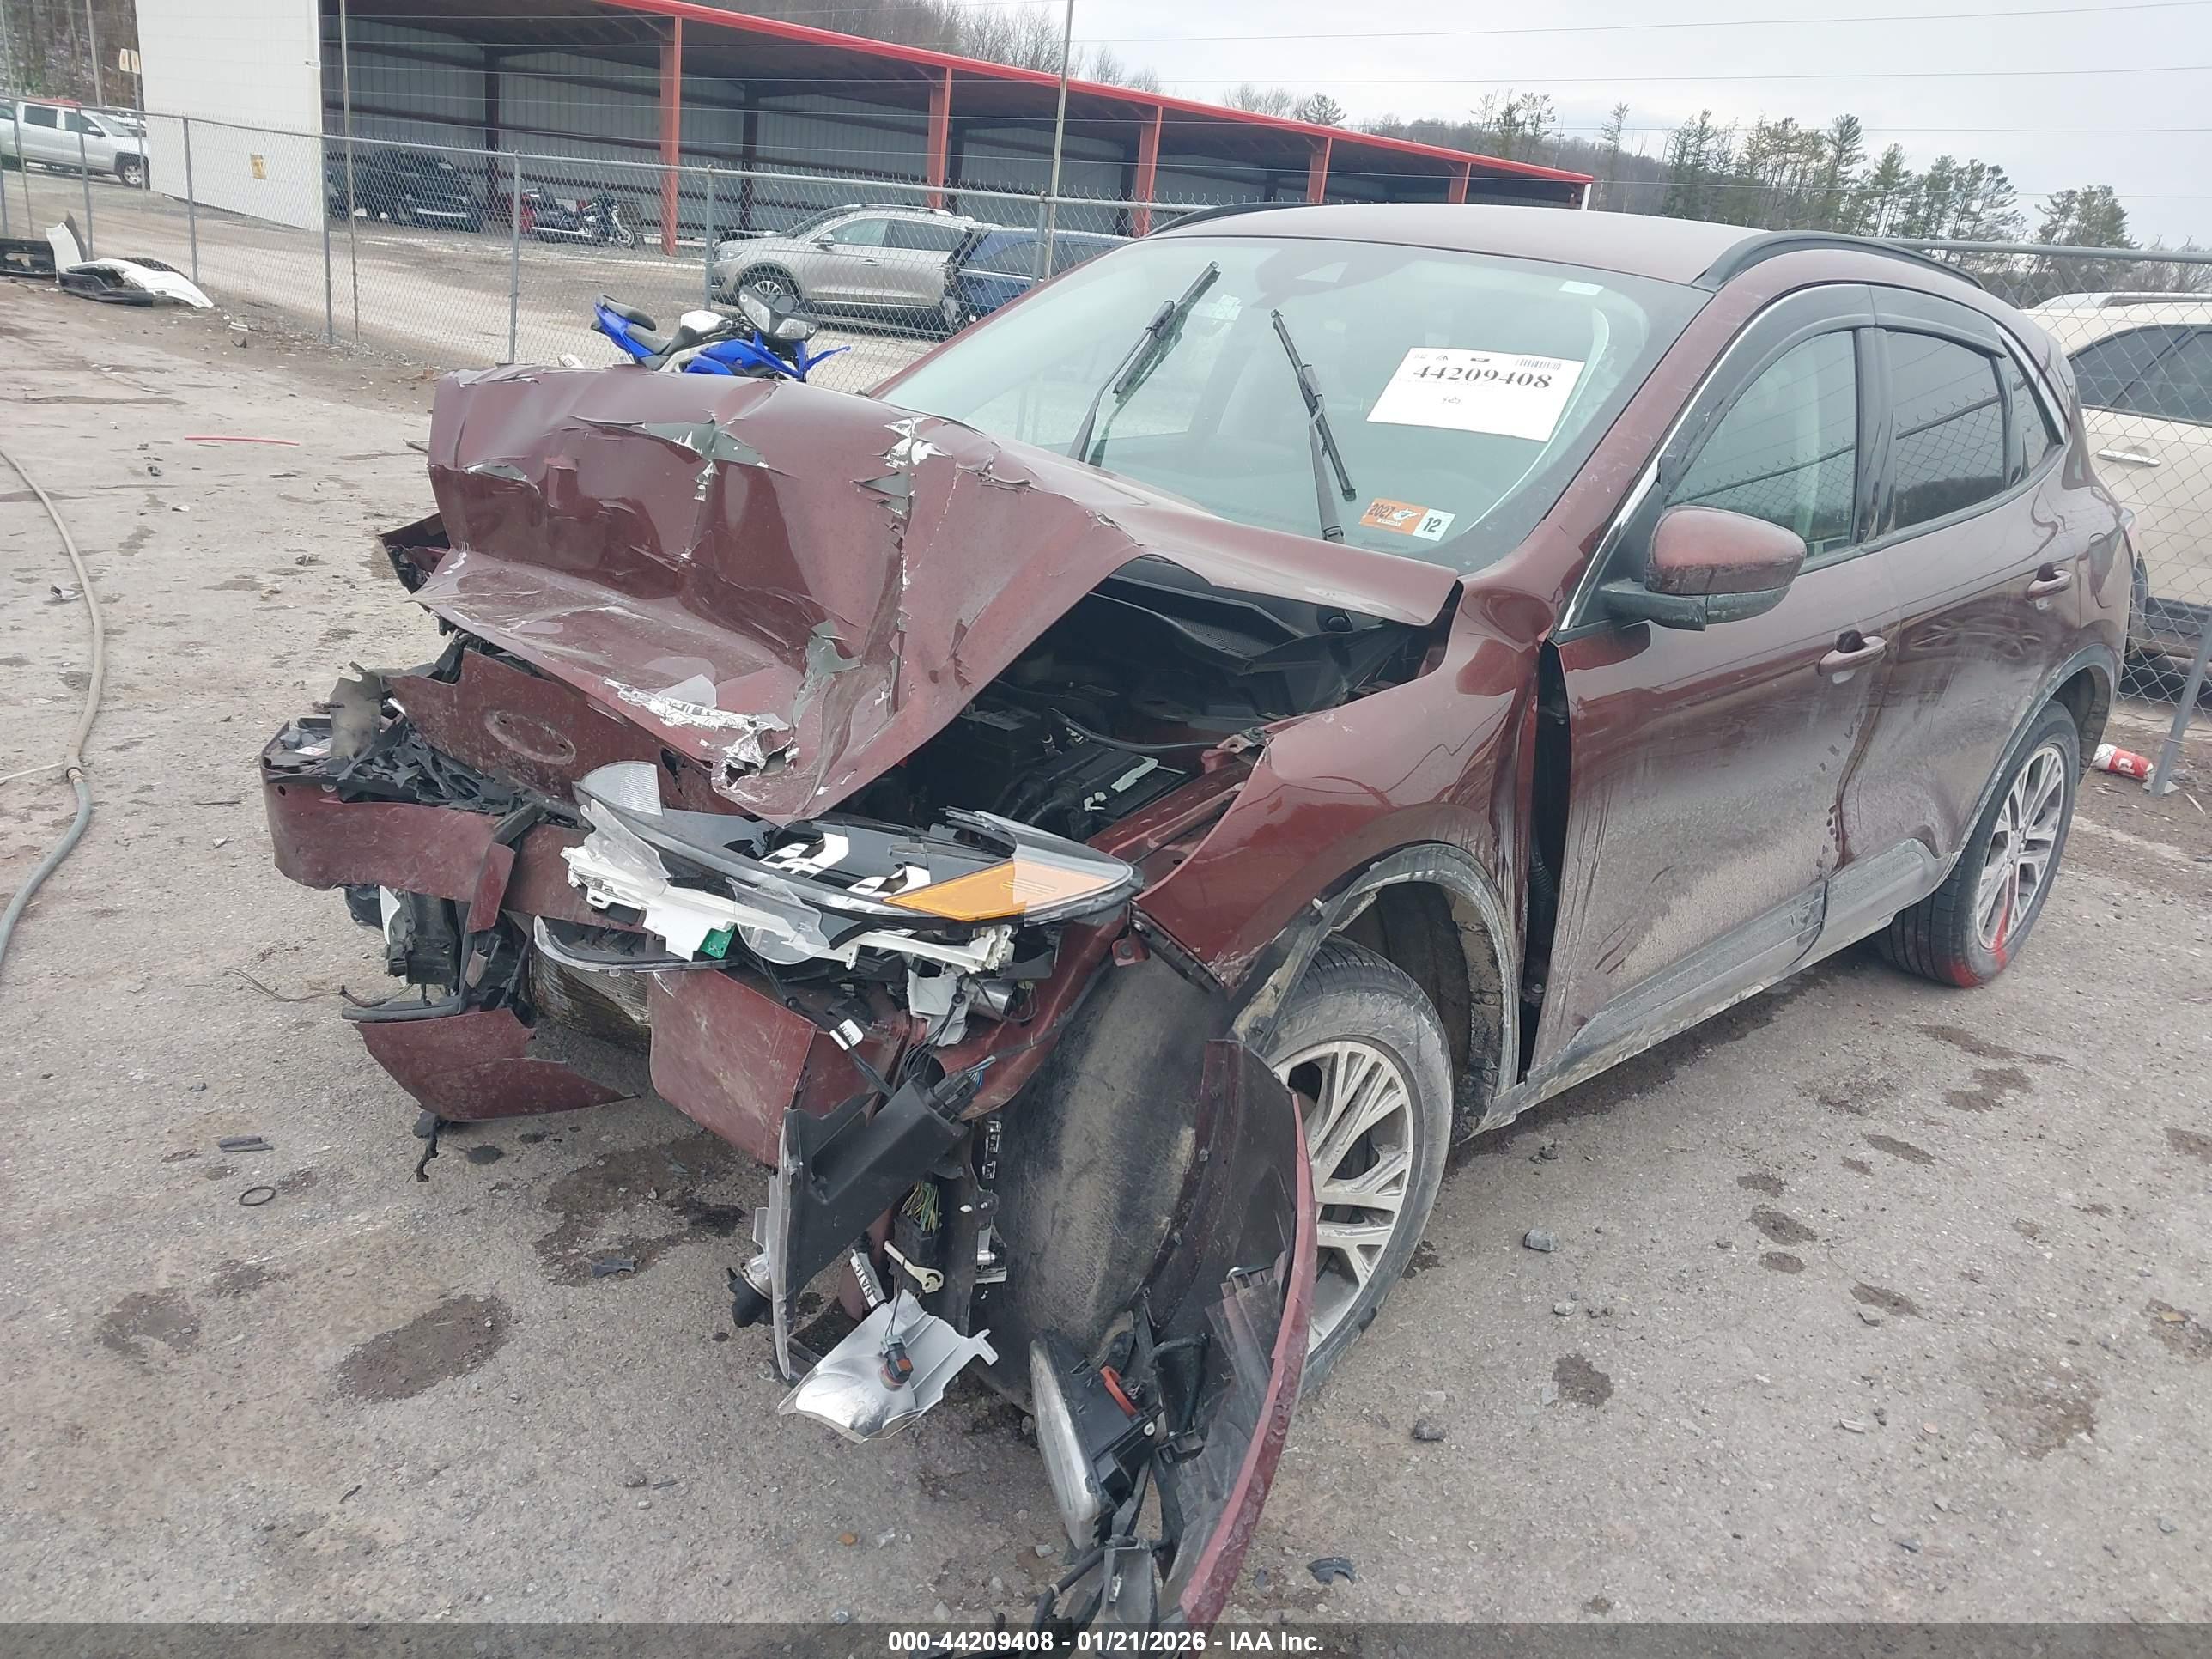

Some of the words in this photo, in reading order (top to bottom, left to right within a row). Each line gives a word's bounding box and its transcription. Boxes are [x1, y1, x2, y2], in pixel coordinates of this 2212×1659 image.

[1411, 365, 1553, 389] 44209408
[1368, 503, 1395, 519] 2027
[1423, 517, 1442, 533] 12
